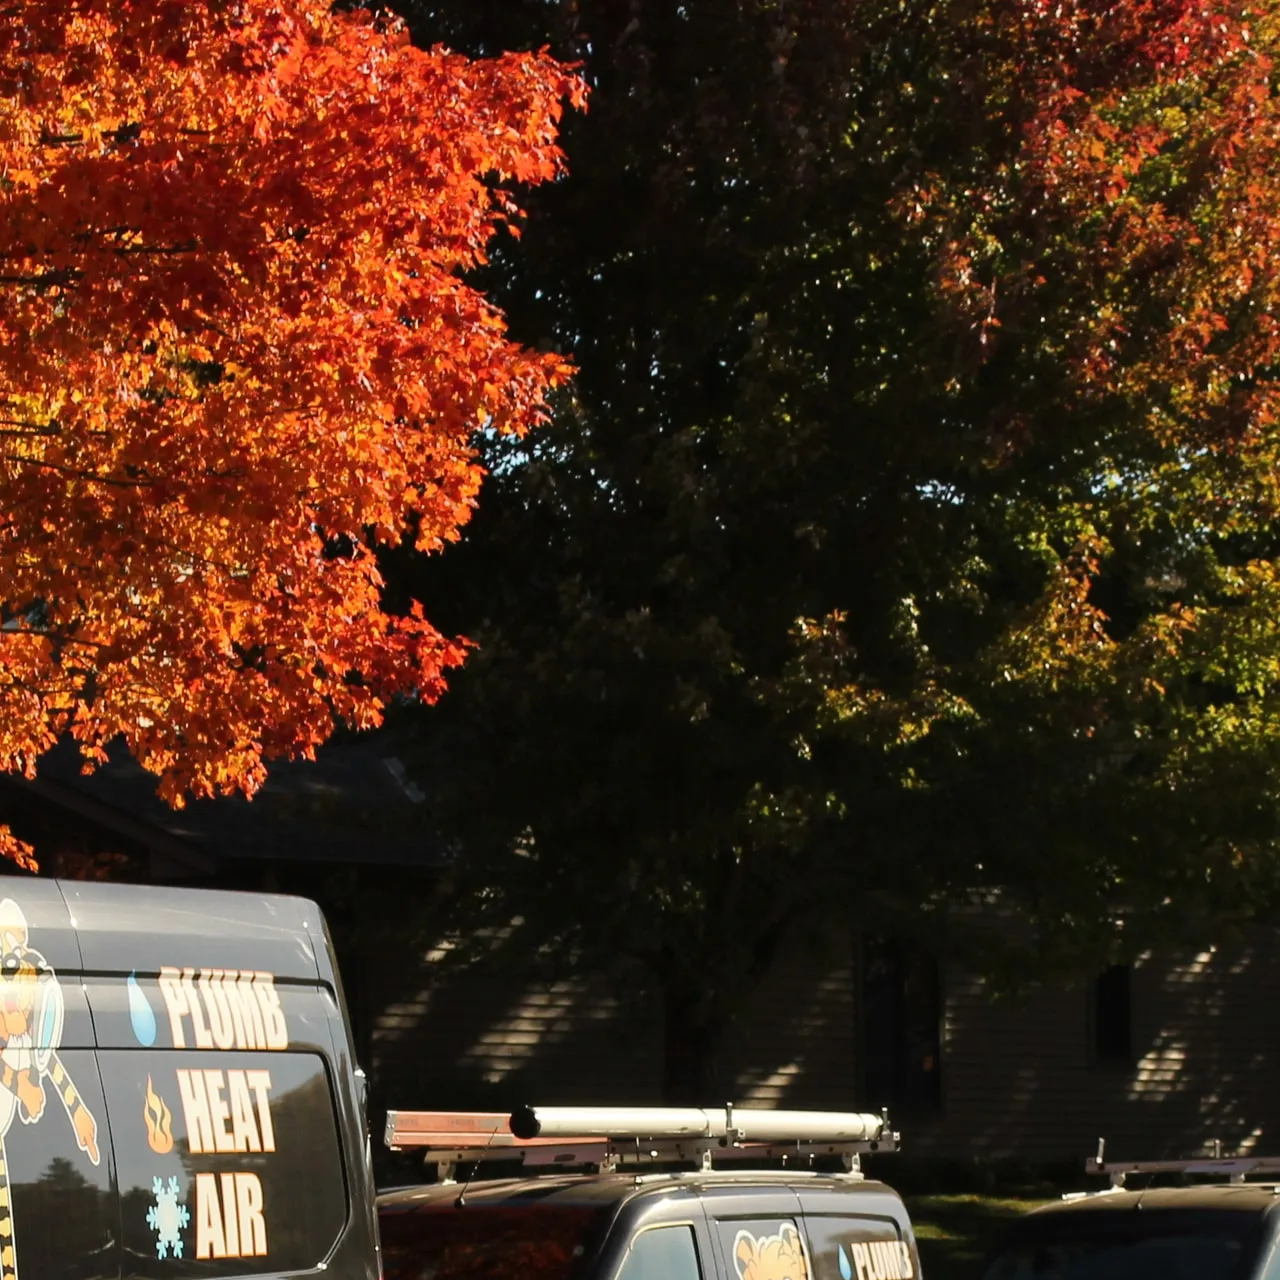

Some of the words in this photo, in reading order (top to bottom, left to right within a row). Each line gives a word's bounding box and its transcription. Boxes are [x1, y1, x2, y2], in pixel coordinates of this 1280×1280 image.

[158, 966, 289, 1050] PLUMB
[176, 1068, 276, 1153] HEAT
[195, 1172, 268, 1259] AIR
